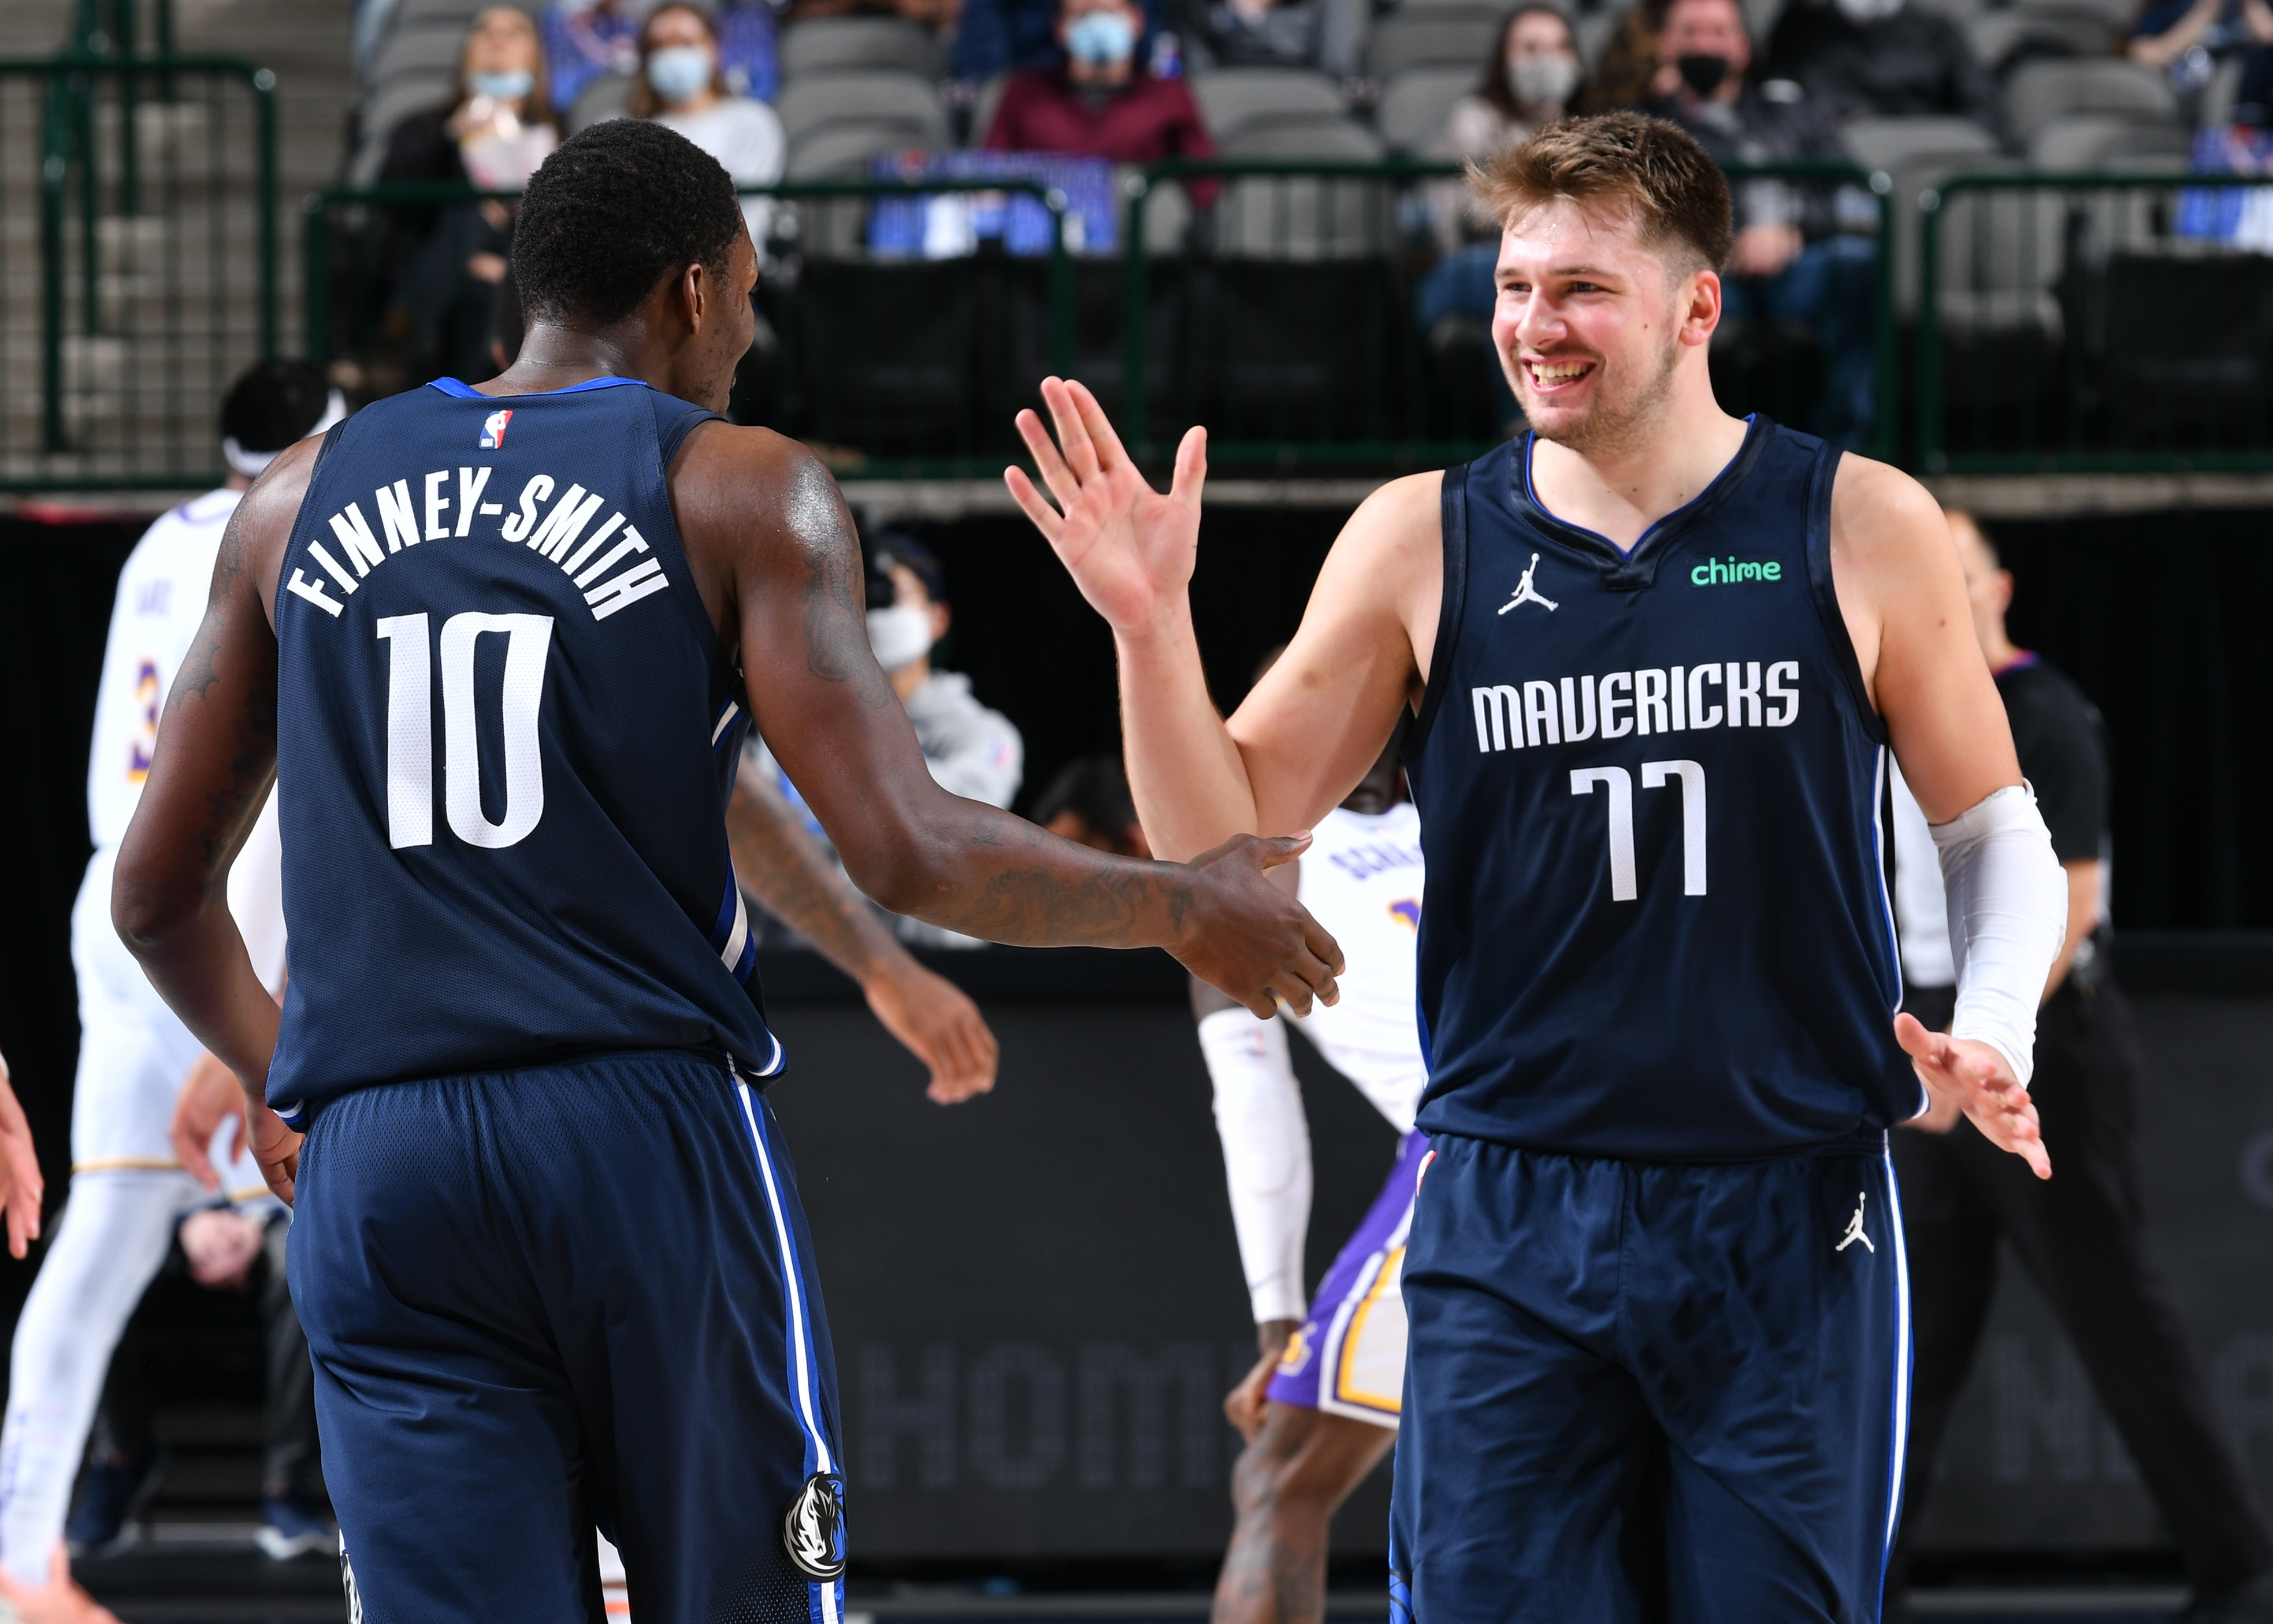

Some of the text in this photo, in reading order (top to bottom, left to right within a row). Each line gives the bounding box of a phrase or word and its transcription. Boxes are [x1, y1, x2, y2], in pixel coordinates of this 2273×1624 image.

[481, 438, 493, 447] NBA
[287, 467, 669, 620] FINNEY-SMITH
[1691, 556, 1781, 586] chime
[377, 611, 555, 849] 10
[1472, 661, 1799, 752] MAVERICKS
[1569, 760, 1707, 901] 77
